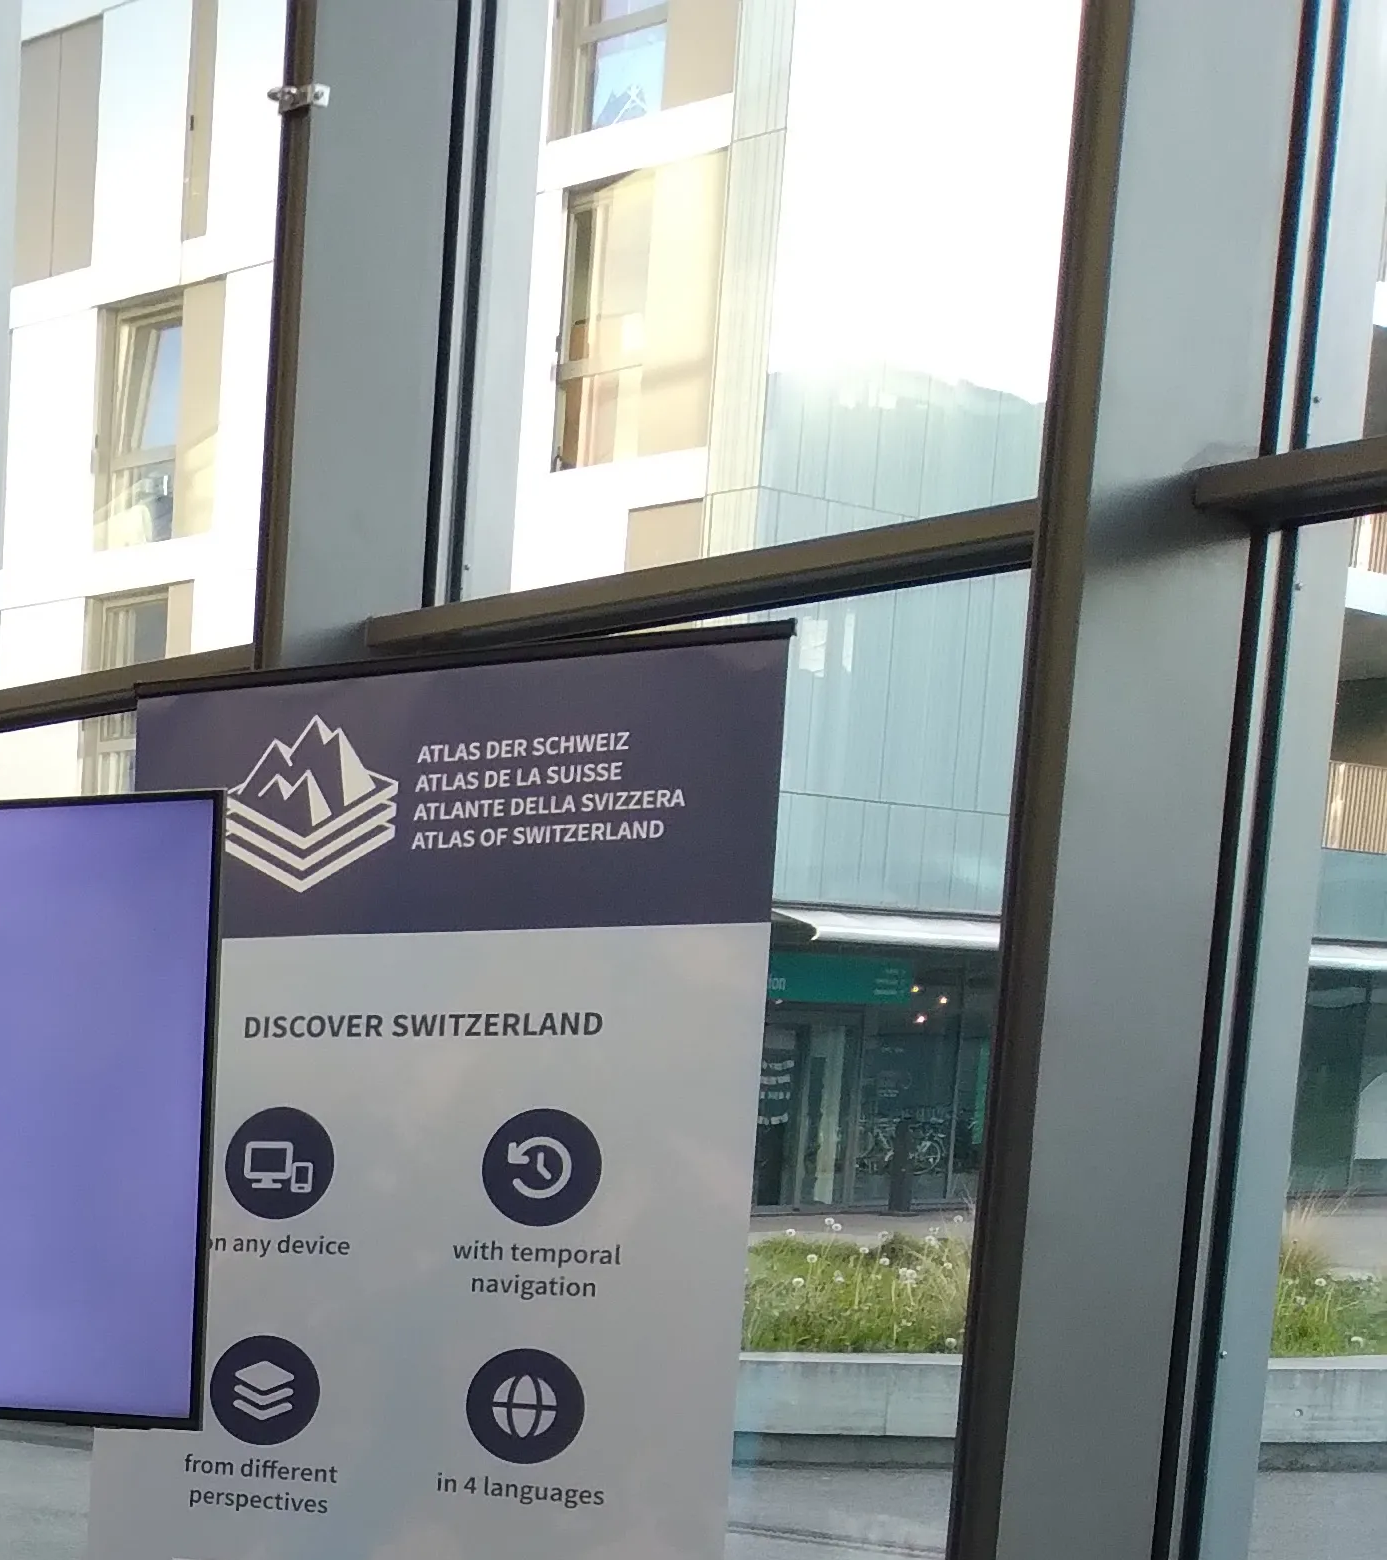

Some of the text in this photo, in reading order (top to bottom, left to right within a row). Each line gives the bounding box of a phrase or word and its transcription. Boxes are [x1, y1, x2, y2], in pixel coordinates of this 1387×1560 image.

[417, 731, 631, 764] ATLAS DER SCHWEIZ
[414, 760, 623, 793] ATLAS DE LA SUISSE
[413, 788, 686, 822] ATLANTE DELLA SVIZZERA
[410, 818, 665, 851] ATLAS OF SWITZERLAND
[243, 1010, 604, 1041] DISCOVER SWITZERLAND
[232, 1236, 272, 1260] any
[277, 1232, 351, 1258] device
[452, 1238, 622, 1268] with temporal
[469, 1272, 598, 1300] navigation
[183, 1451, 339, 1485] from different
[188, 1486, 329, 1517] perspectives
[435, 1471, 606, 1509] in 4 languages
